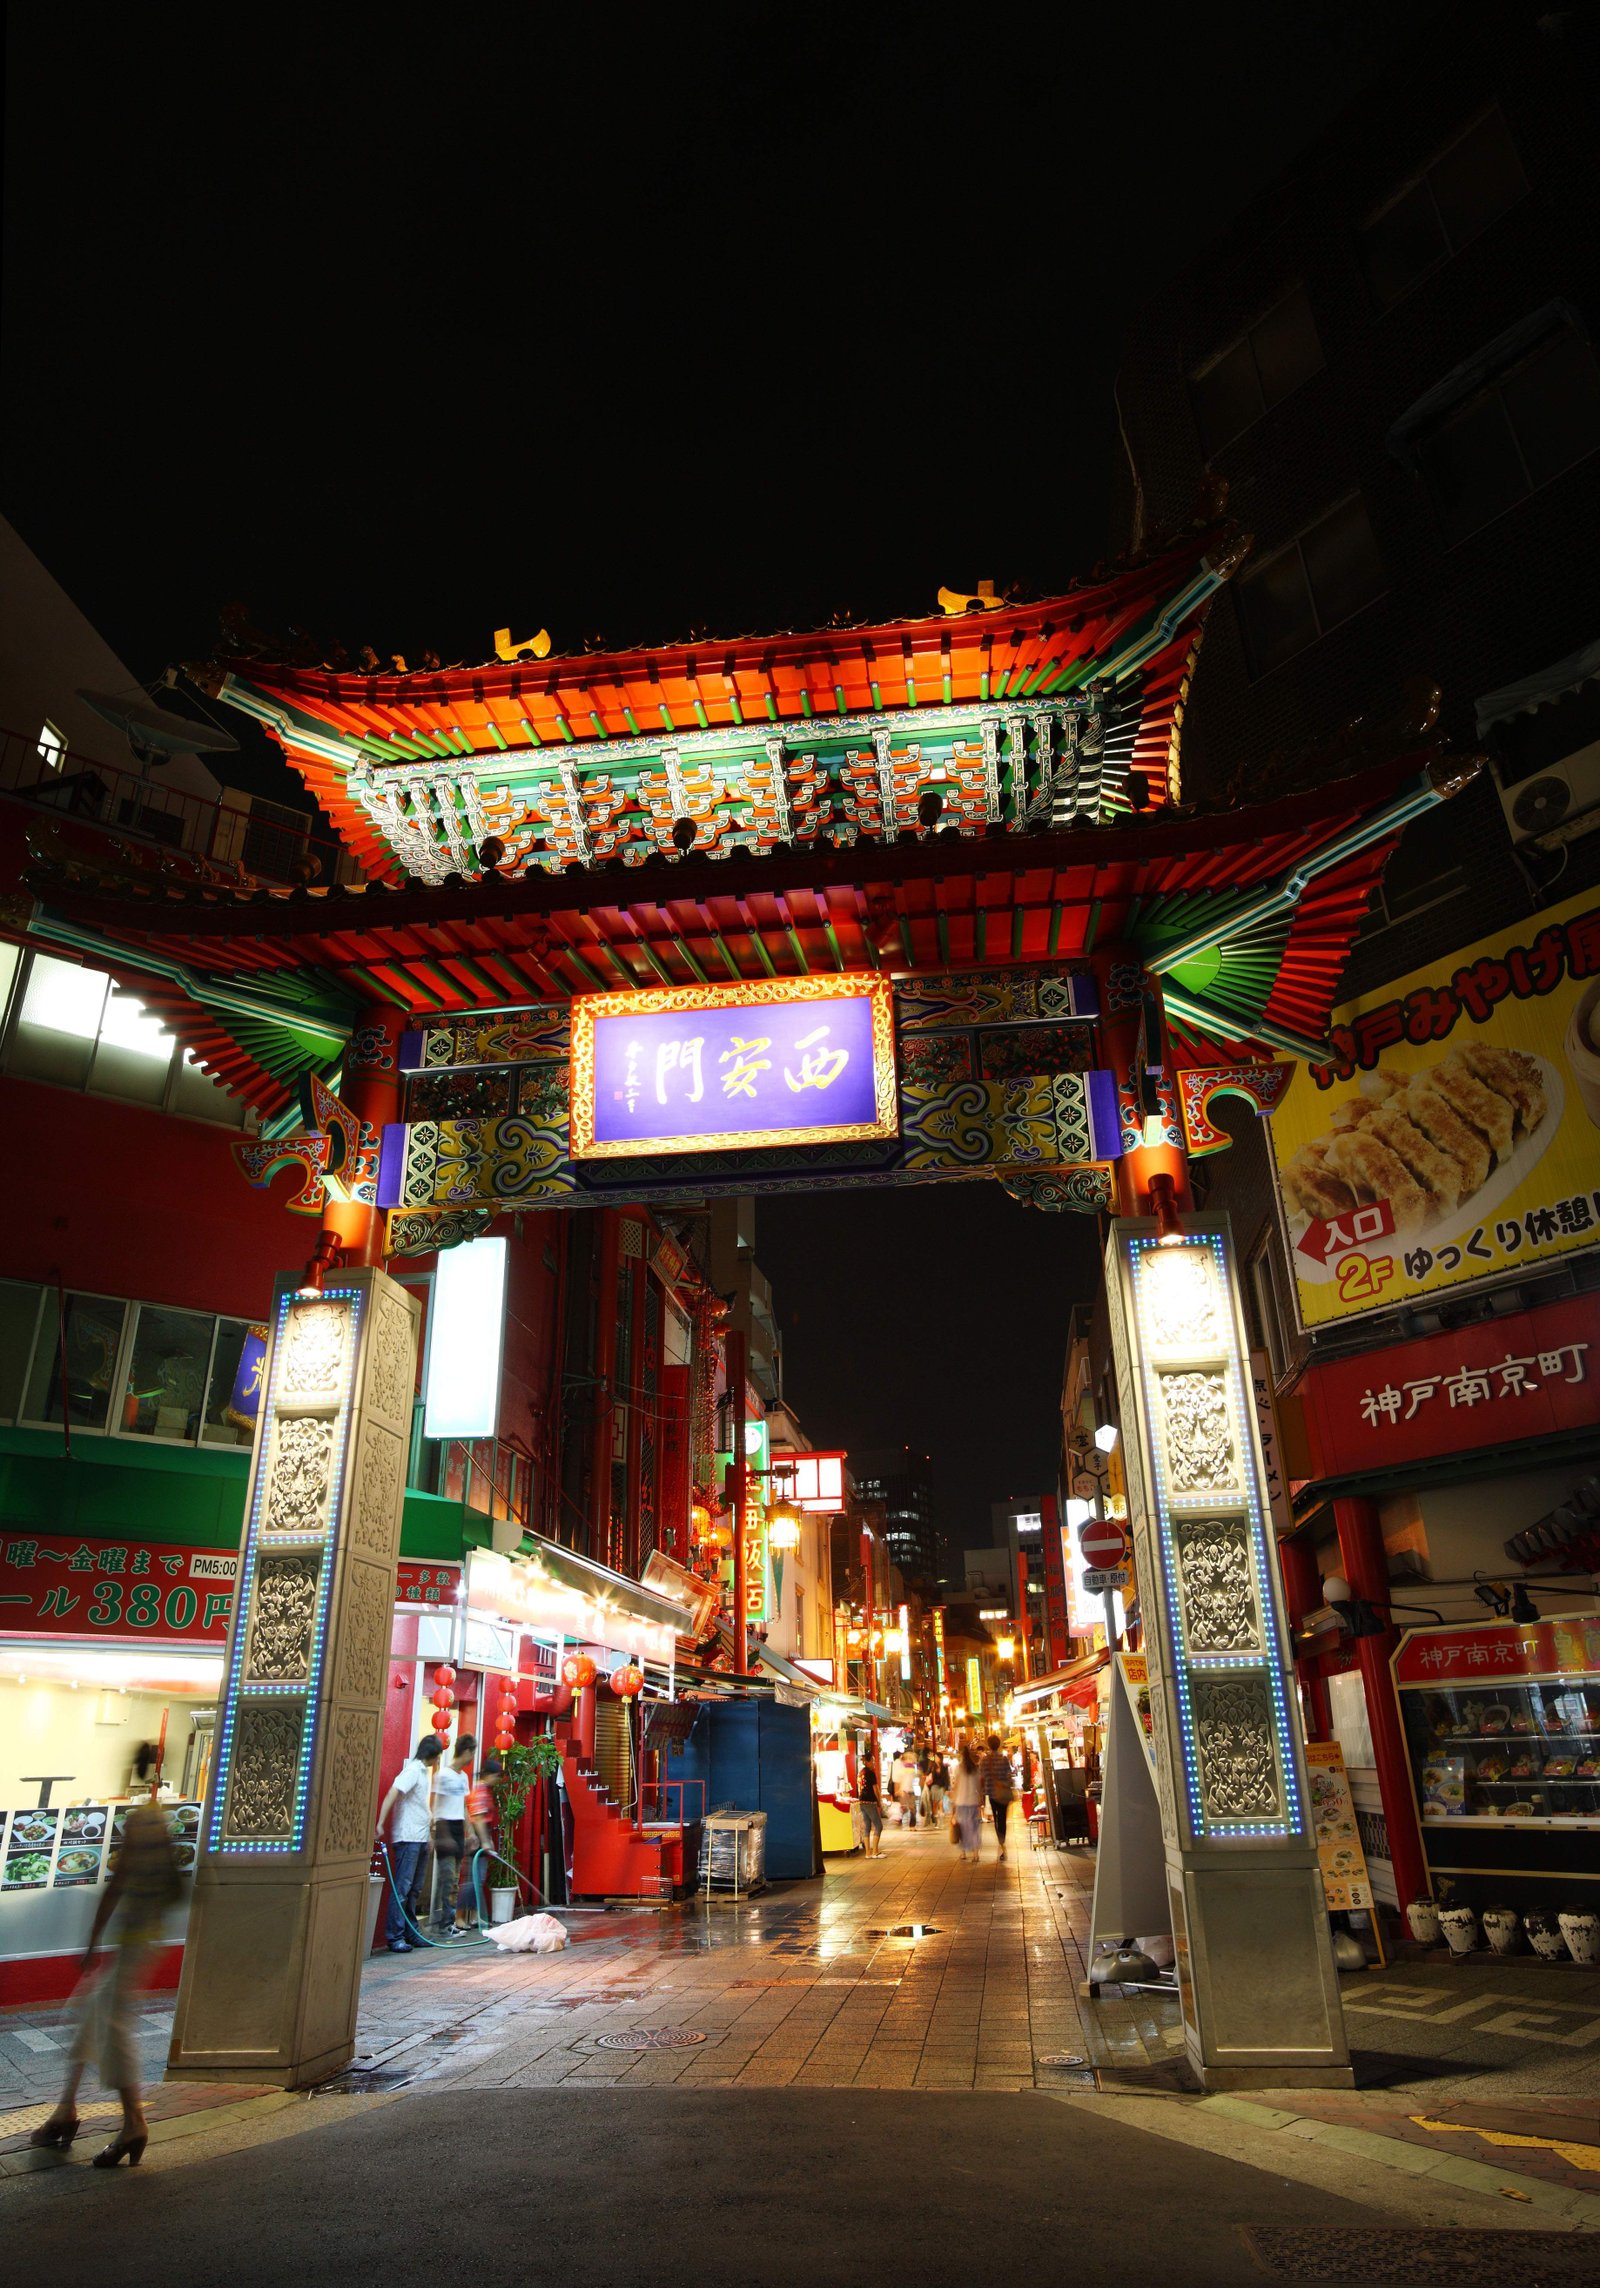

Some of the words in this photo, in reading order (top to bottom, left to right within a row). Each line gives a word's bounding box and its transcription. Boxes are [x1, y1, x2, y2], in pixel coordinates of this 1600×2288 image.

[1324, 1207, 1384, 1253] 入口
[1336, 1252, 1394, 1303] 2F
[1360, 1343, 1588, 1427] 神戸南京町
[0, 1540, 185, 1575] 曜〜金曜まで
[1084, 1571, 1127, 1587] 自動車・原付
[1419, 1640, 1540, 1669] 神戸南京町
